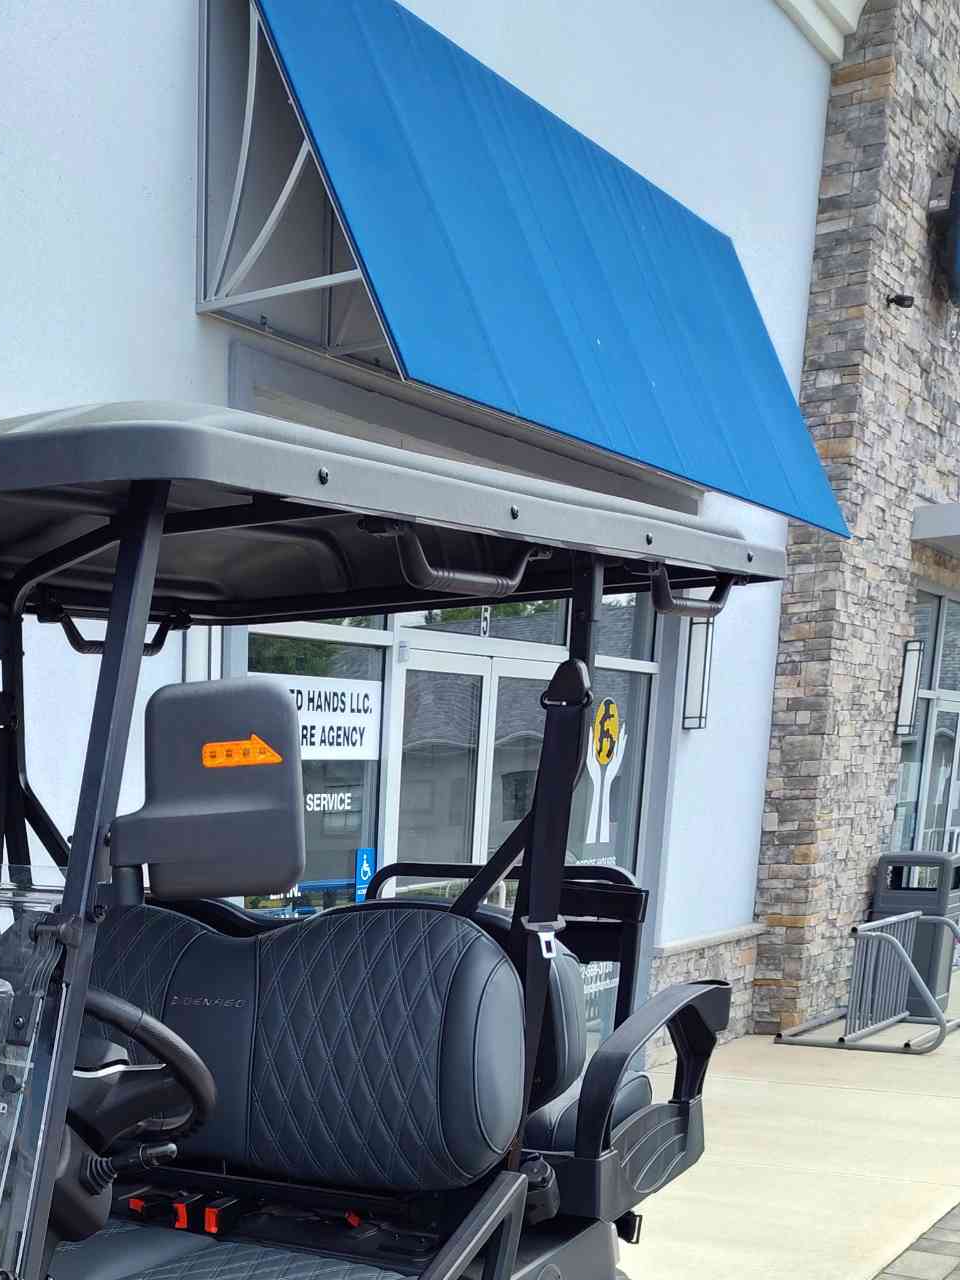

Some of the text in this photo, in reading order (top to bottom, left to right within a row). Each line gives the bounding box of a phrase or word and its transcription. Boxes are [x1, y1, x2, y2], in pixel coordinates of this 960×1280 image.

[307, 689, 346, 713] HANDS
[350, 691, 373, 714] LLC.
[319, 725, 366, 747] AGENCY
[306, 792, 352, 811] SERVICE
